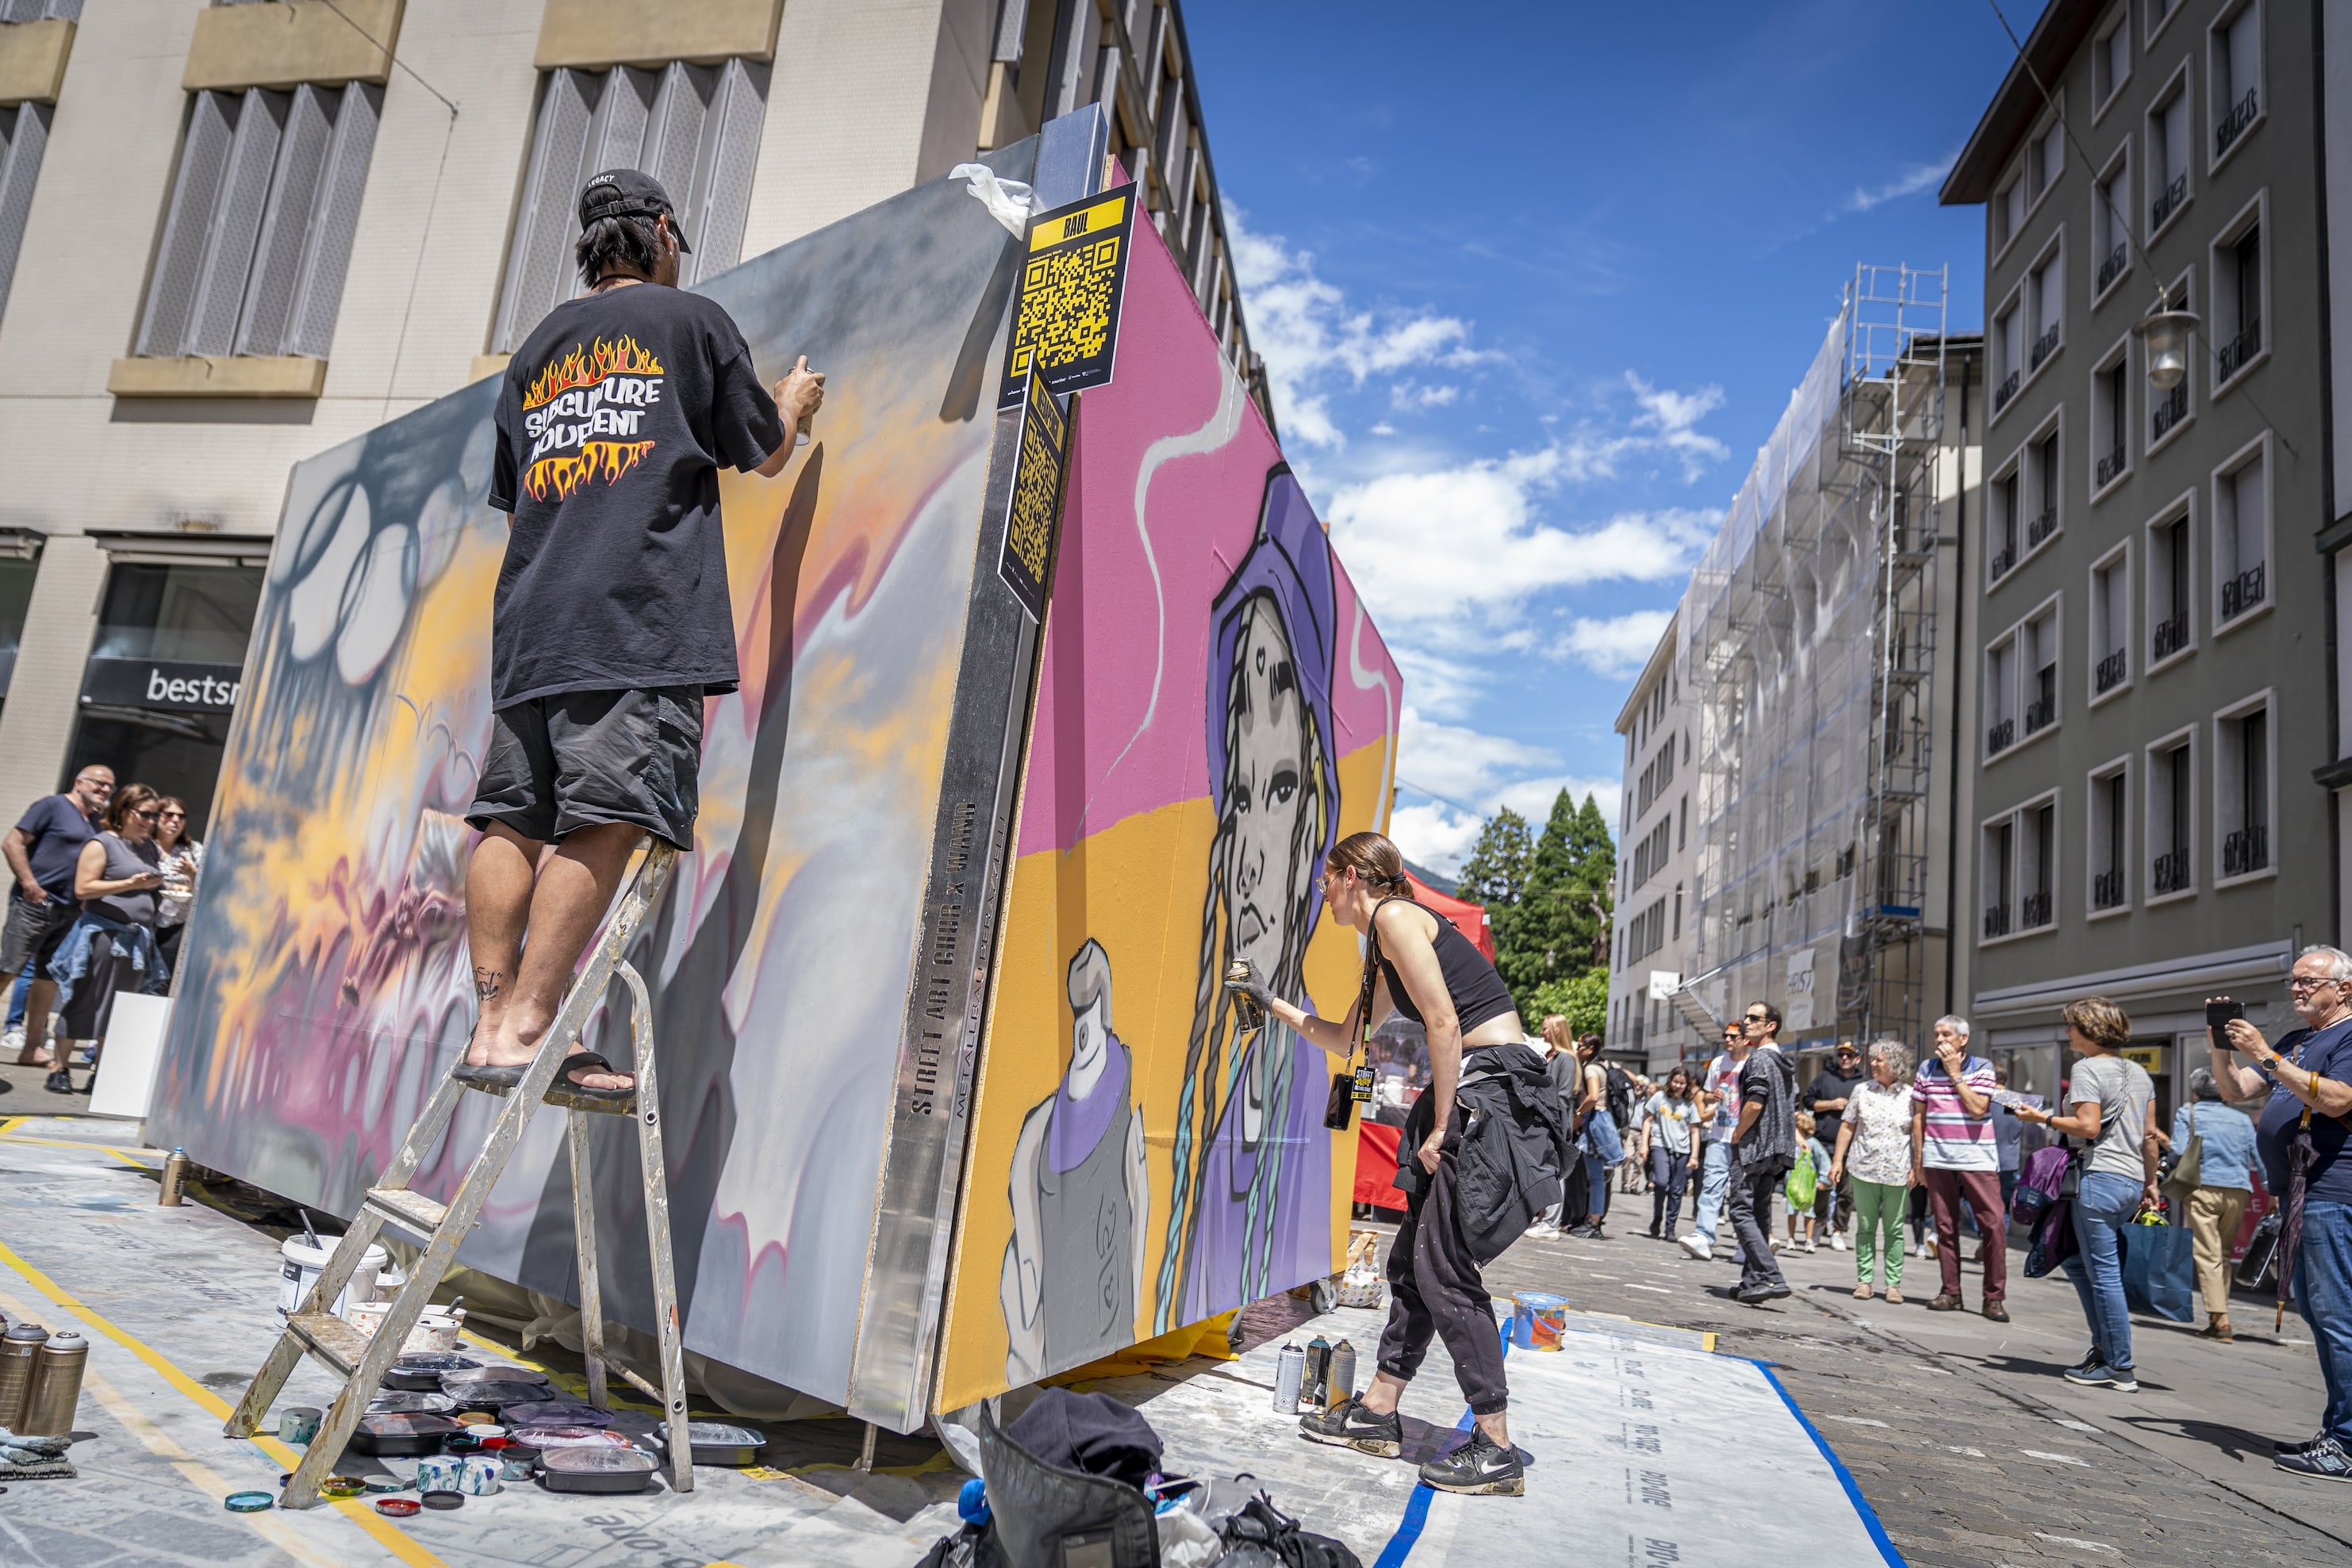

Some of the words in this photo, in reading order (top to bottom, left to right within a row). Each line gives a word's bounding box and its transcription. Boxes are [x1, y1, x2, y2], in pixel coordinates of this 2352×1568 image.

[588, 174, 615, 187] LEGACY
[1063, 212, 1088, 239] BAUL
[946, 803, 976, 873] WAND
[925, 975, 950, 1020] ART
[957, 967, 984, 1118] METALLBAU
[911, 1029, 942, 1115] STREET
